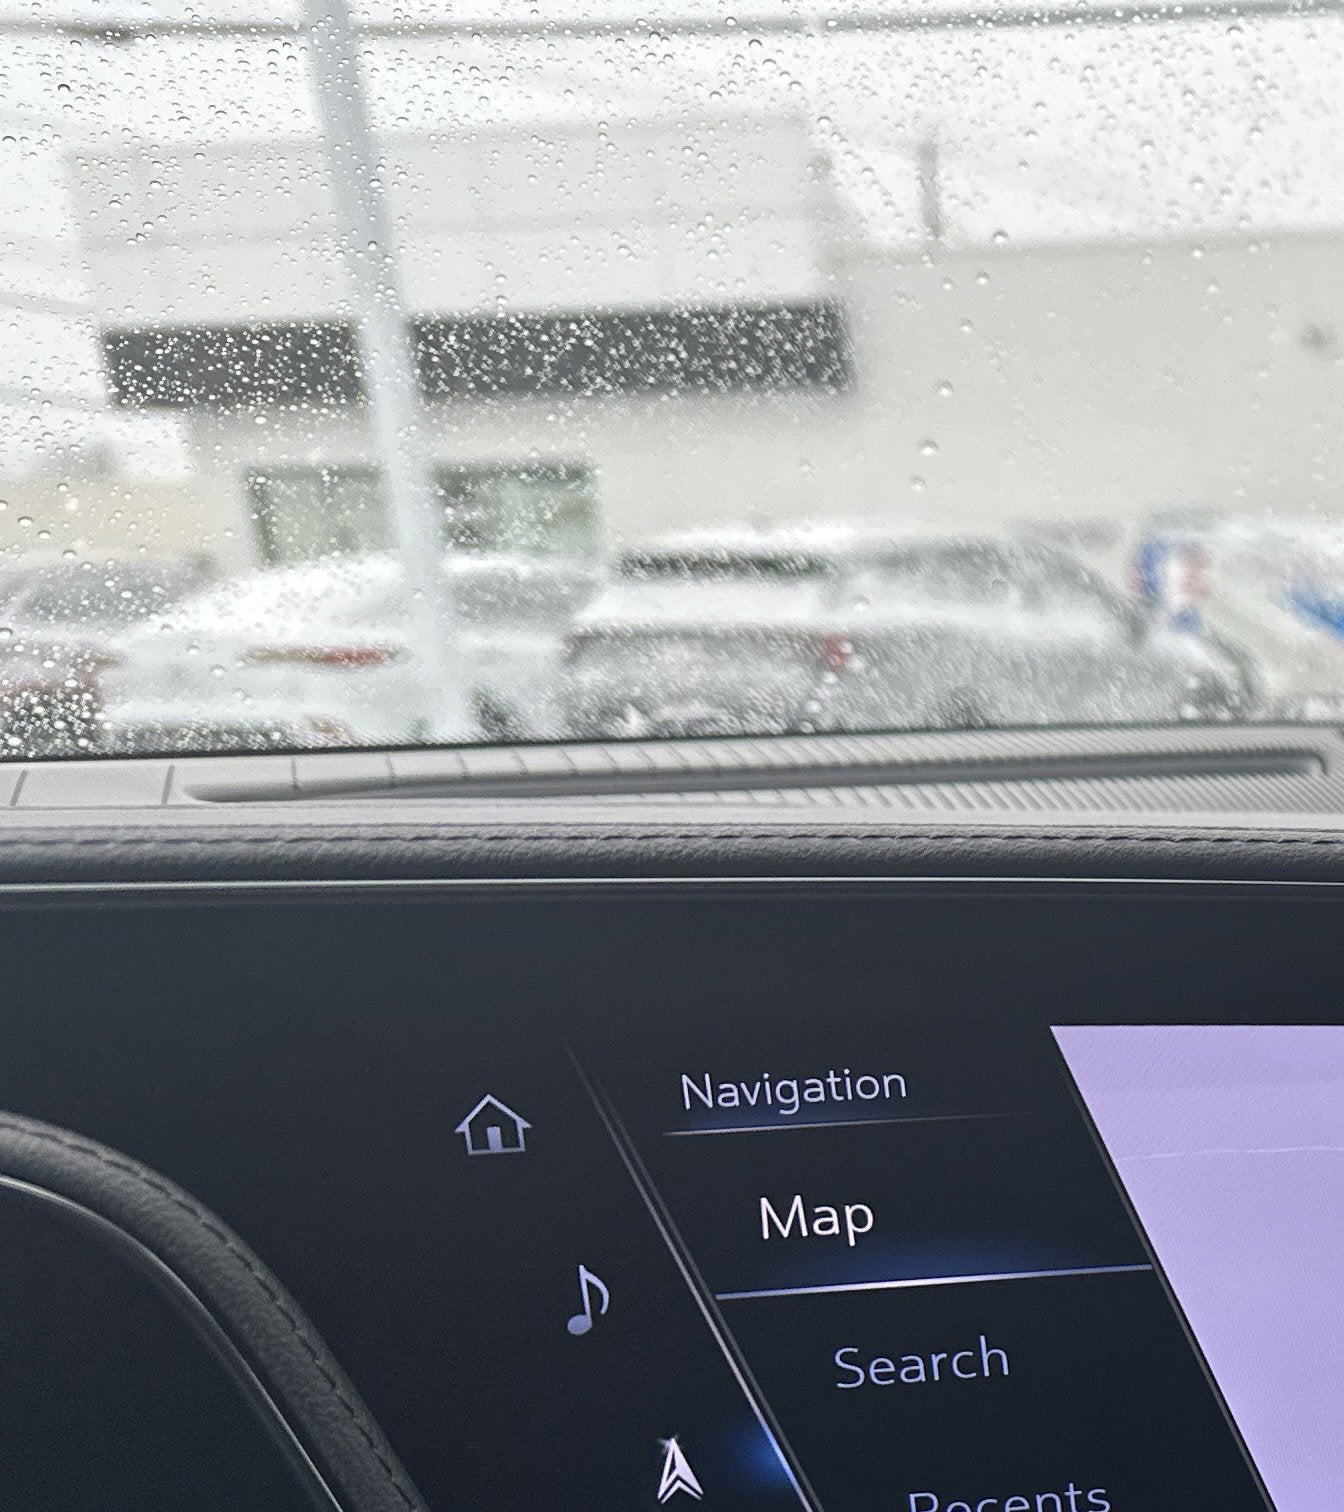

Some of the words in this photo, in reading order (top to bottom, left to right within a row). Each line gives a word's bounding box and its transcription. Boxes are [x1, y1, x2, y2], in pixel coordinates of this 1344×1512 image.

[681, 1068, 908, 1115] Navigation
[758, 1194, 875, 1246] Map
[835, 1335, 1010, 1390] Search
